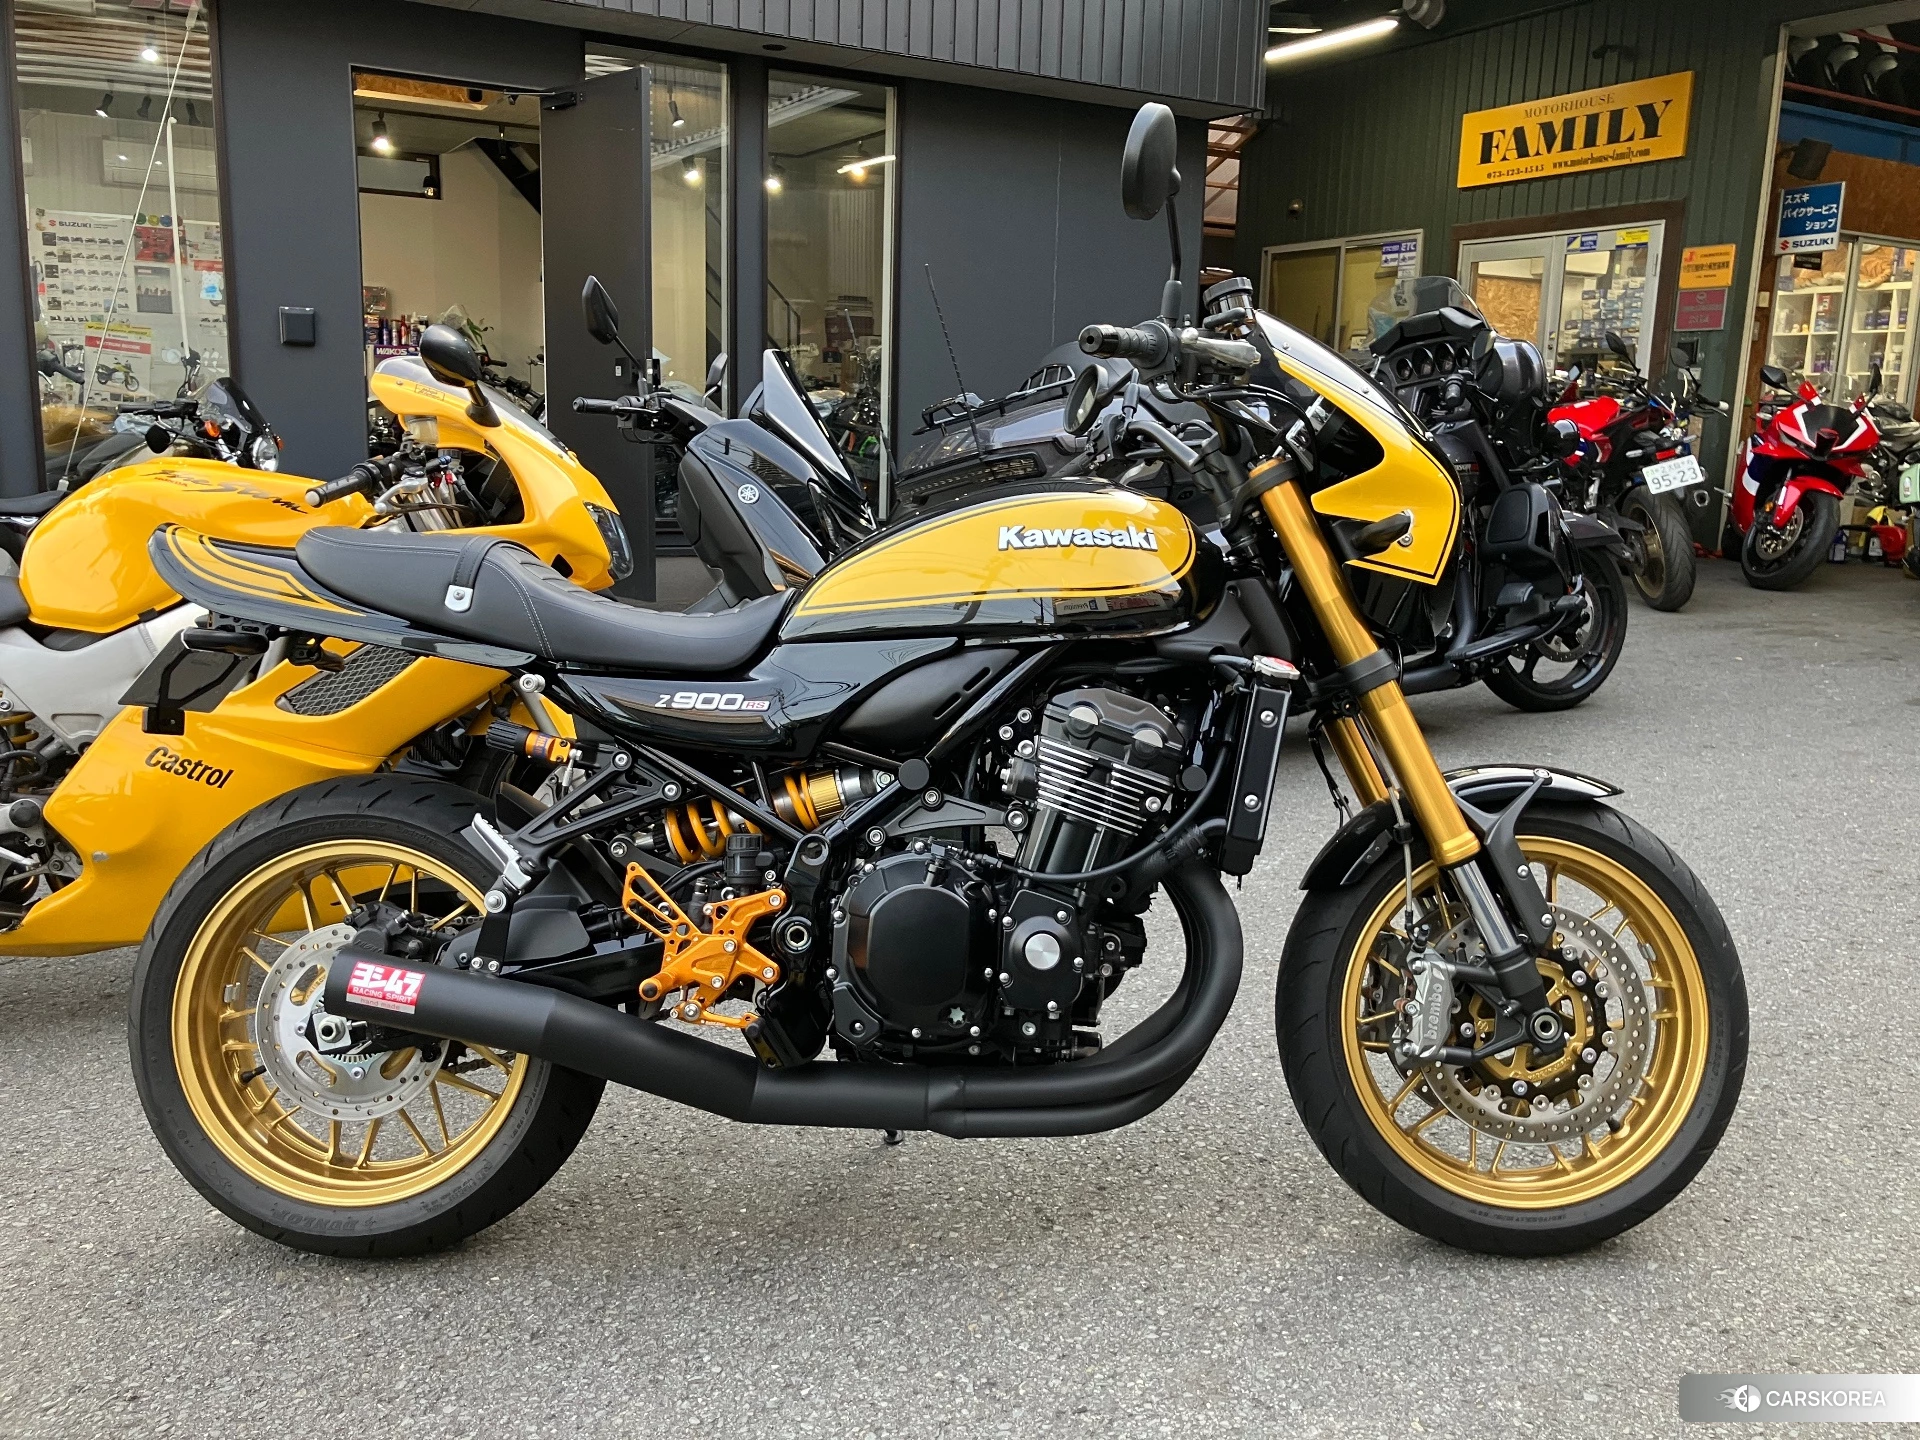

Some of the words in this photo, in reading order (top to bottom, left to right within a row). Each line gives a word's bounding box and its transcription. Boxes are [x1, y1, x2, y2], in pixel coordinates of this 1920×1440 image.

[1523, 92, 1615, 119] MOTORHOUSE
[1477, 98, 1674, 165] FAMILY
[1784, 193, 1810, 204] スズキ
[1783, 203, 1837, 219] バイクサービス
[58, 220, 92, 228] SUZUKI
[1805, 218, 1837, 231] ショップ
[1401, 241, 1417, 251] ETC
[1792, 237, 1834, 248] SUZUKI
[998, 525, 1159, 552] Kawasaki
[145, 746, 235, 789] Castrol
[350, 961, 424, 996] ヨシムラ
[352, 986, 383, 999] RACING
[385, 992, 412, 1004] SPIRIT
[360, 998, 379, 1007] hand
[380, 1000, 401, 1011] made
[1423, 983, 1443, 1040] brembo
